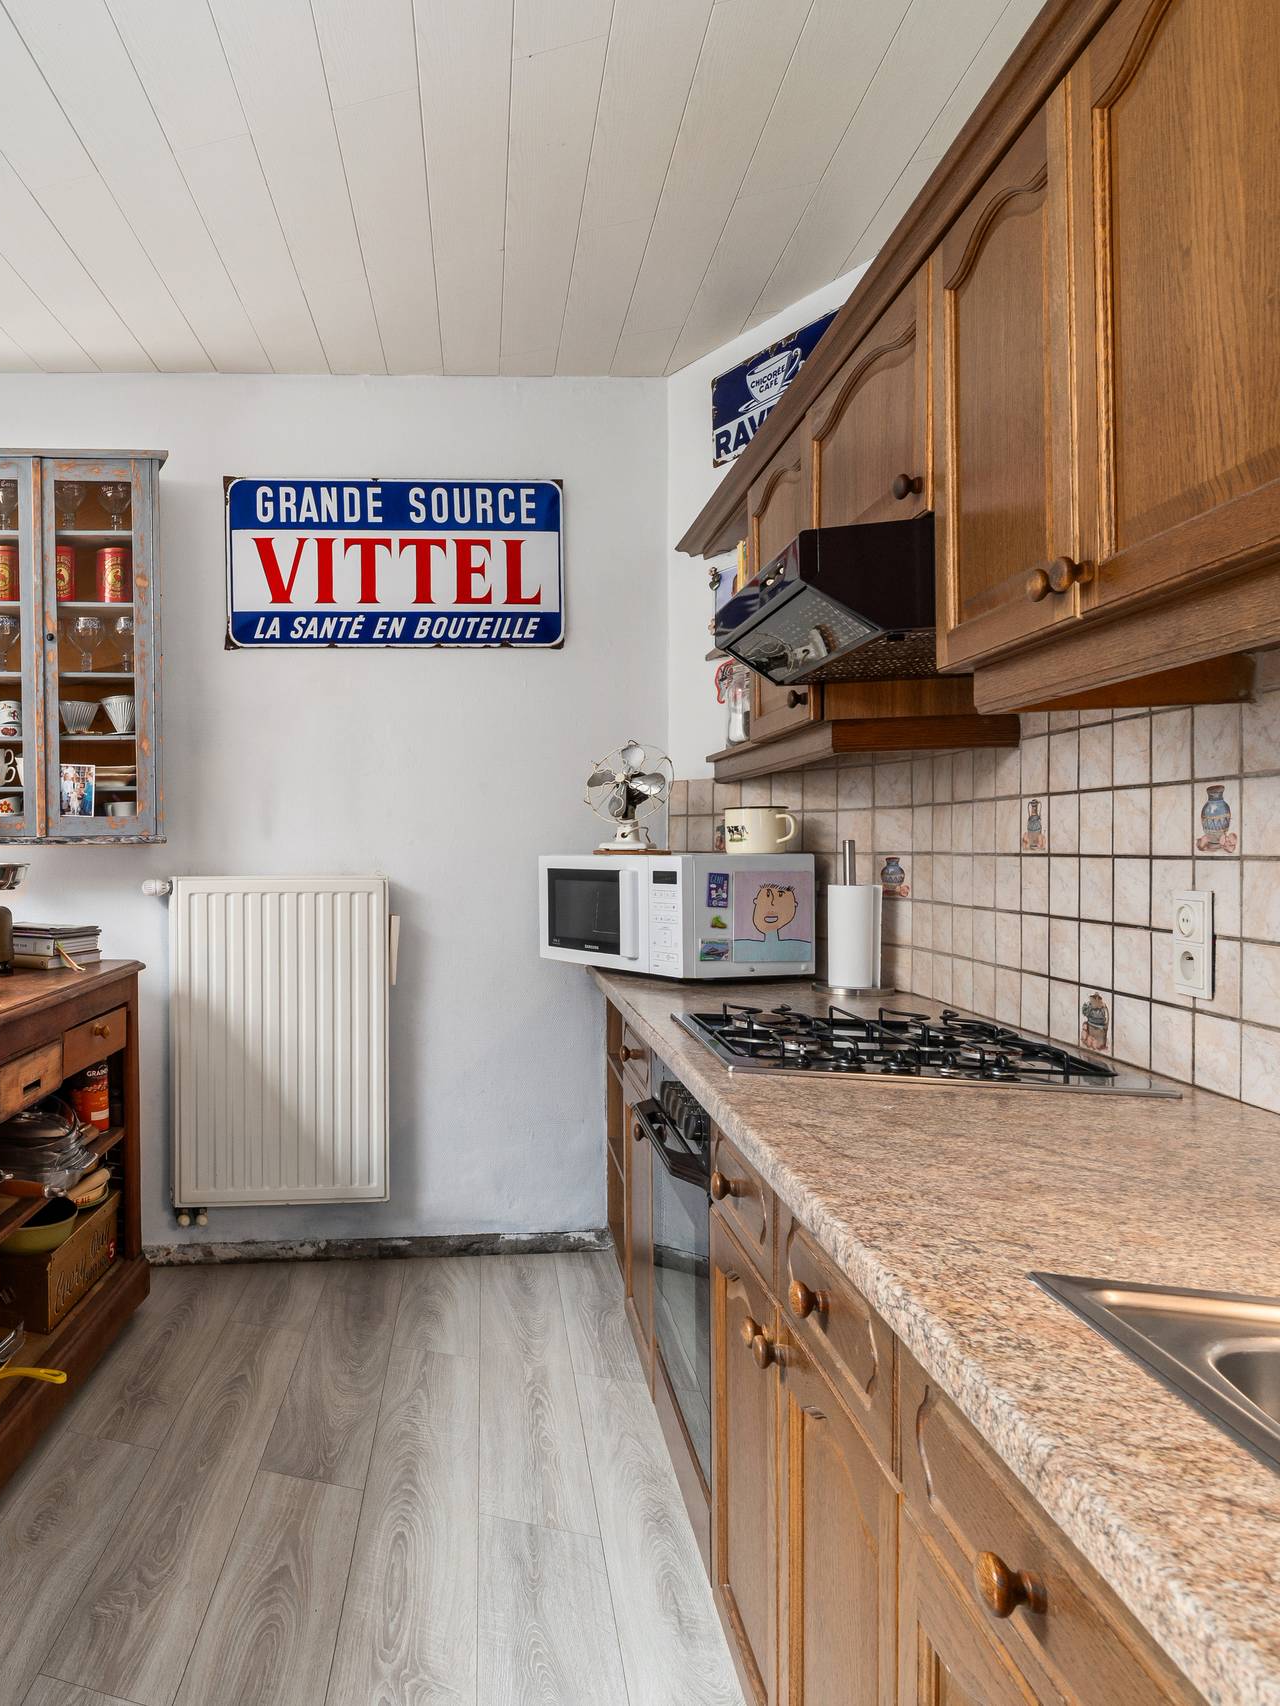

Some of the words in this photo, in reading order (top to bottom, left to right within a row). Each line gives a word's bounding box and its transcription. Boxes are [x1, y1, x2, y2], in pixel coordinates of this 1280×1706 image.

[750, 363, 787, 389] CHICORÉE
[715, 408, 775, 459] RAV
[255, 486, 383, 523] GRANDE
[408, 486, 536, 525] SOURCE
[251, 536, 542, 606] VITTEL
[254, 616, 281, 639] LA
[289, 614, 365, 640] SANTÉ
[373, 617, 401, 640] EN
[414, 617, 541, 640] BOUTEILLE
[109, 1242, 115, 1258] 5
